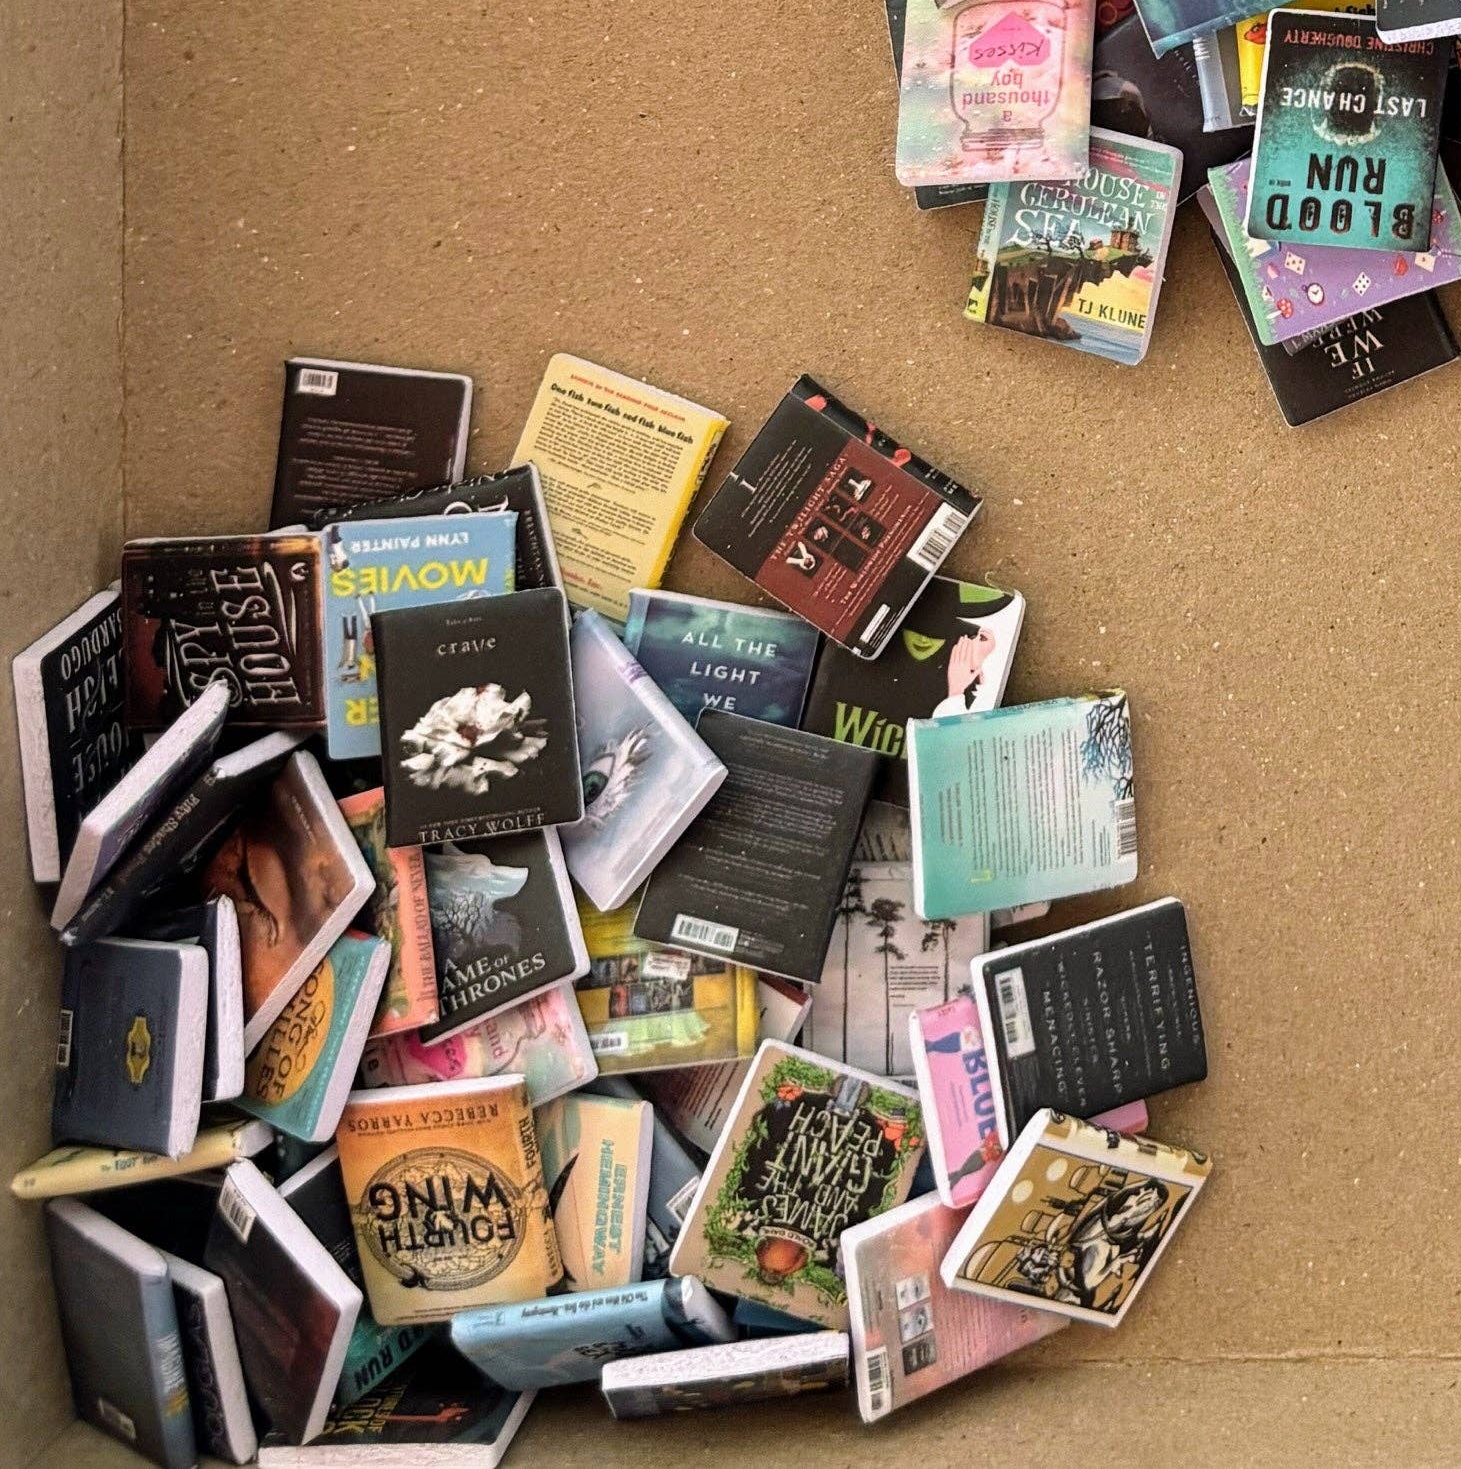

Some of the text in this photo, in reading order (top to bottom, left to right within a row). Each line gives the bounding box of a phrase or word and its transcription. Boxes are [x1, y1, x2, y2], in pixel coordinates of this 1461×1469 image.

[973, 39, 1047, 62] Kisses
[1284, 30, 1434, 57] CHRISTINE DOUGHERTY
[990, 72, 1025, 92] boy
[960, 88, 1053, 109] thousand
[1280, 85, 1429, 118] LAST CHANCE
[1001, 110, 1013, 122] a
[1307, 152, 1386, 193] RUN
[1019, 184, 1156, 237] CERULEAN
[1265, 192, 1417, 241] BLOOD
[1076, 297, 1148, 331] TJ KLUNE
[1325, 333, 1385, 369] WE
[1351, 357, 1375, 380] IF
[350, 532, 470, 556] LYNN PAINTER
[330, 558, 489, 598] MOVIES
[209, 565, 302, 705] HOUSE
[681, 630, 779, 658] ALL THE
[689, 661, 762, 686] LIGHT
[702, 692, 737, 712] WE
[417, 813, 547, 845] TRACY WOLFF
[443, 958, 457, 974] A
[437, 952, 547, 1017] THRONES
[349, 1103, 499, 1131] REBECCA YARROS
[788, 1100, 886, 1158] PEACH
[368, 1172, 511, 1221] WING
[379, 1213, 516, 1252] FOURTH
